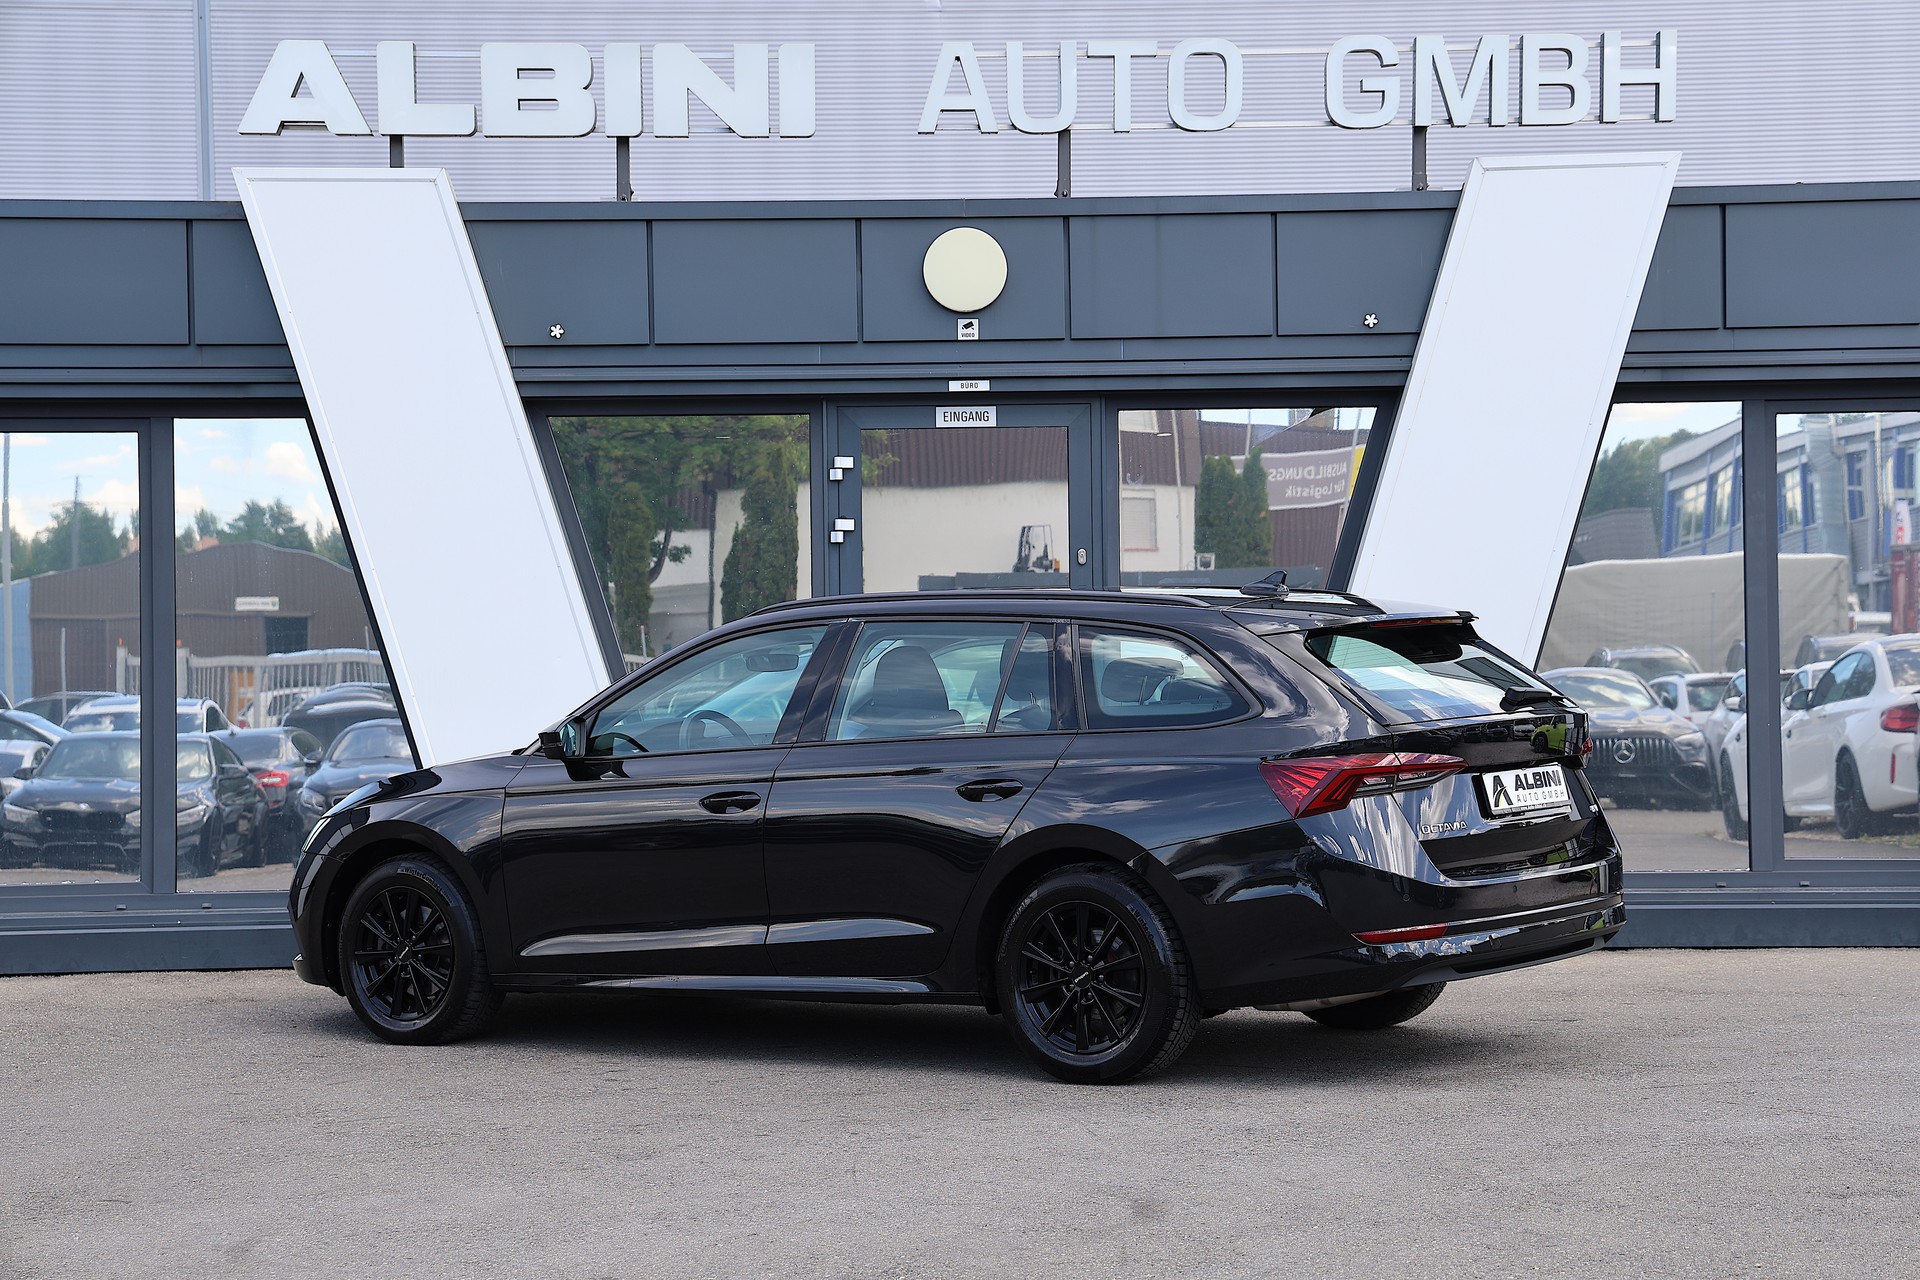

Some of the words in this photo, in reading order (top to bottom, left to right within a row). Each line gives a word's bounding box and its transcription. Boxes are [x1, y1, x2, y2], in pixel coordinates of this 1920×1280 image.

[237, 39, 816, 138] ALBINI
[917, 37, 1244, 134] AUTO
[1325, 29, 1678, 128] GMBH
[960, 381, 979, 389] BÜRO
[943, 410, 990, 422] EINGANG
[1514, 769, 1562, 792] ALBINI
[1516, 792, 1539, 803] AUTO
[1542, 789, 1565, 800] GMBH
[1421, 820, 1468, 834] OCTAVIA
